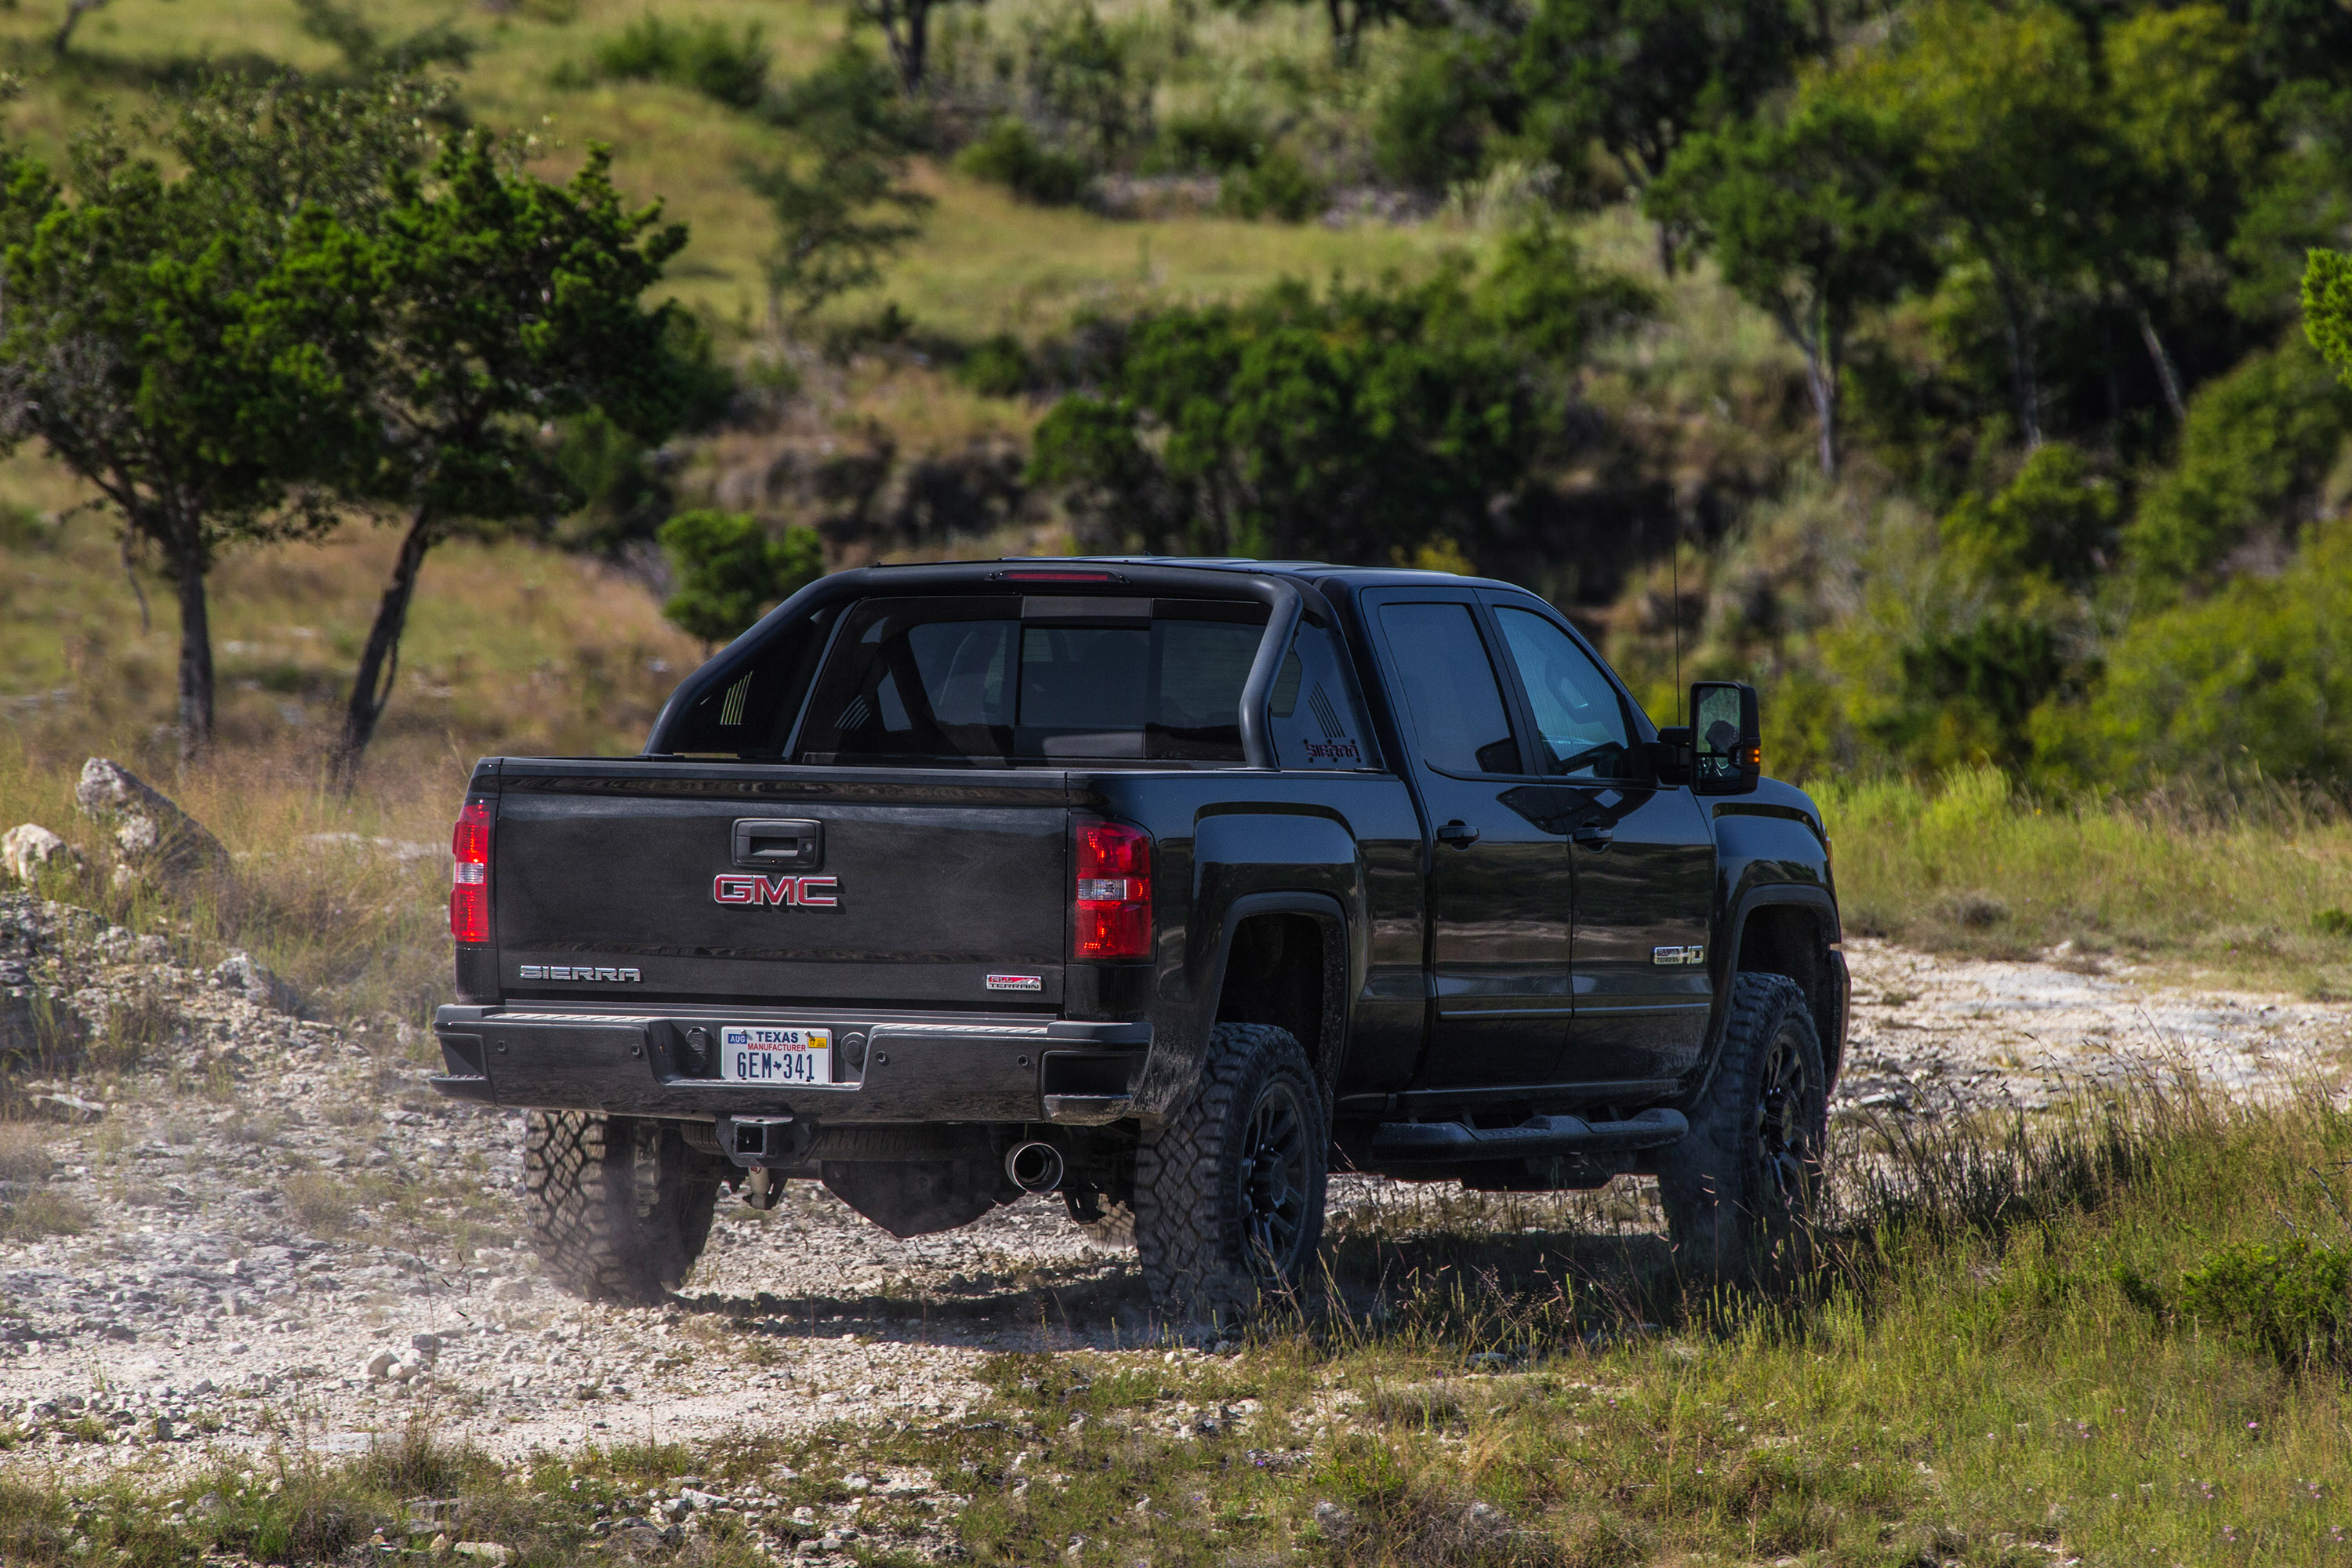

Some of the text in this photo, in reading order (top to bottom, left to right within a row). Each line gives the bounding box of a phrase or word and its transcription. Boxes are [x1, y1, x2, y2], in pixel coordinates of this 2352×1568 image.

[1306, 744, 1360, 757] SIERRA
[714, 874, 838, 906] GMC
[520, 965, 641, 982] SIERRA
[756, 1031, 798, 1044] TEXAS
[747, 1043, 806, 1052] MANUFACTURER
[737, 1052, 815, 1080] 6EM 341
